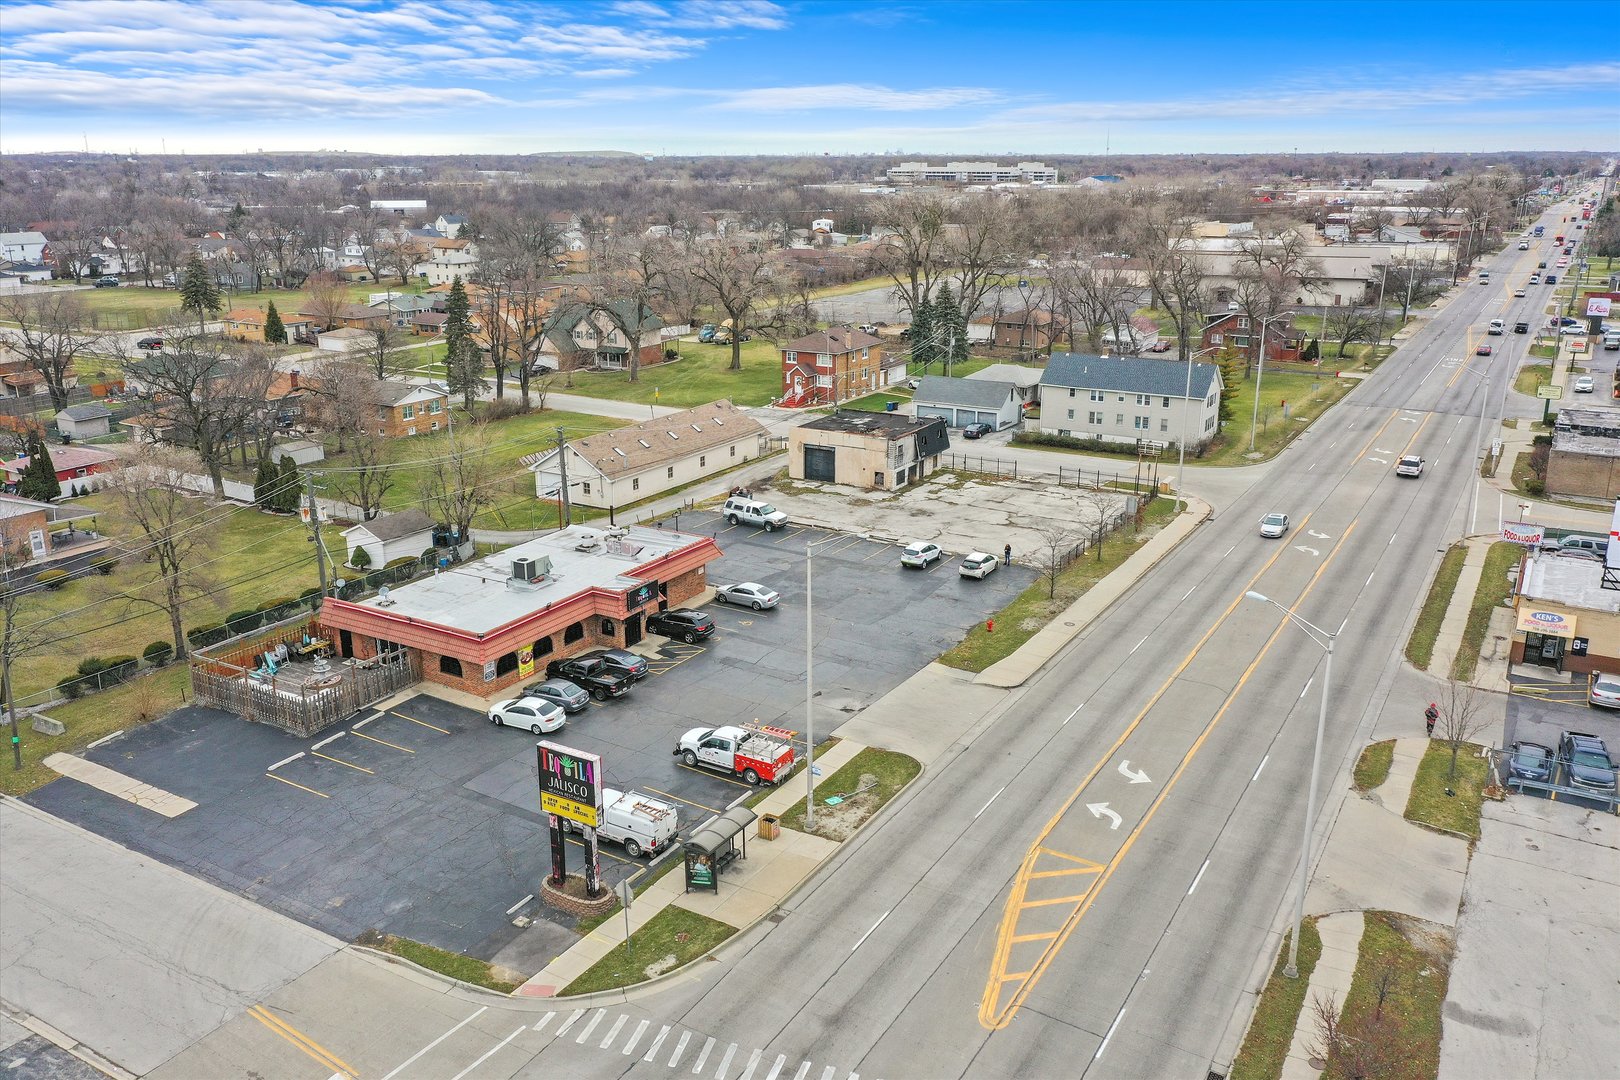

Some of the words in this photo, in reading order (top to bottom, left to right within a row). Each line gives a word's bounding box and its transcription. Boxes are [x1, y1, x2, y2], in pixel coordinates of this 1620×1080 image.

[1504, 529, 1517, 540] FOOD
[1521, 534, 1540, 543] LIQUOR
[1536, 613, 1558, 622] KEN'S
[548, 777, 588, 797] JALISCO
